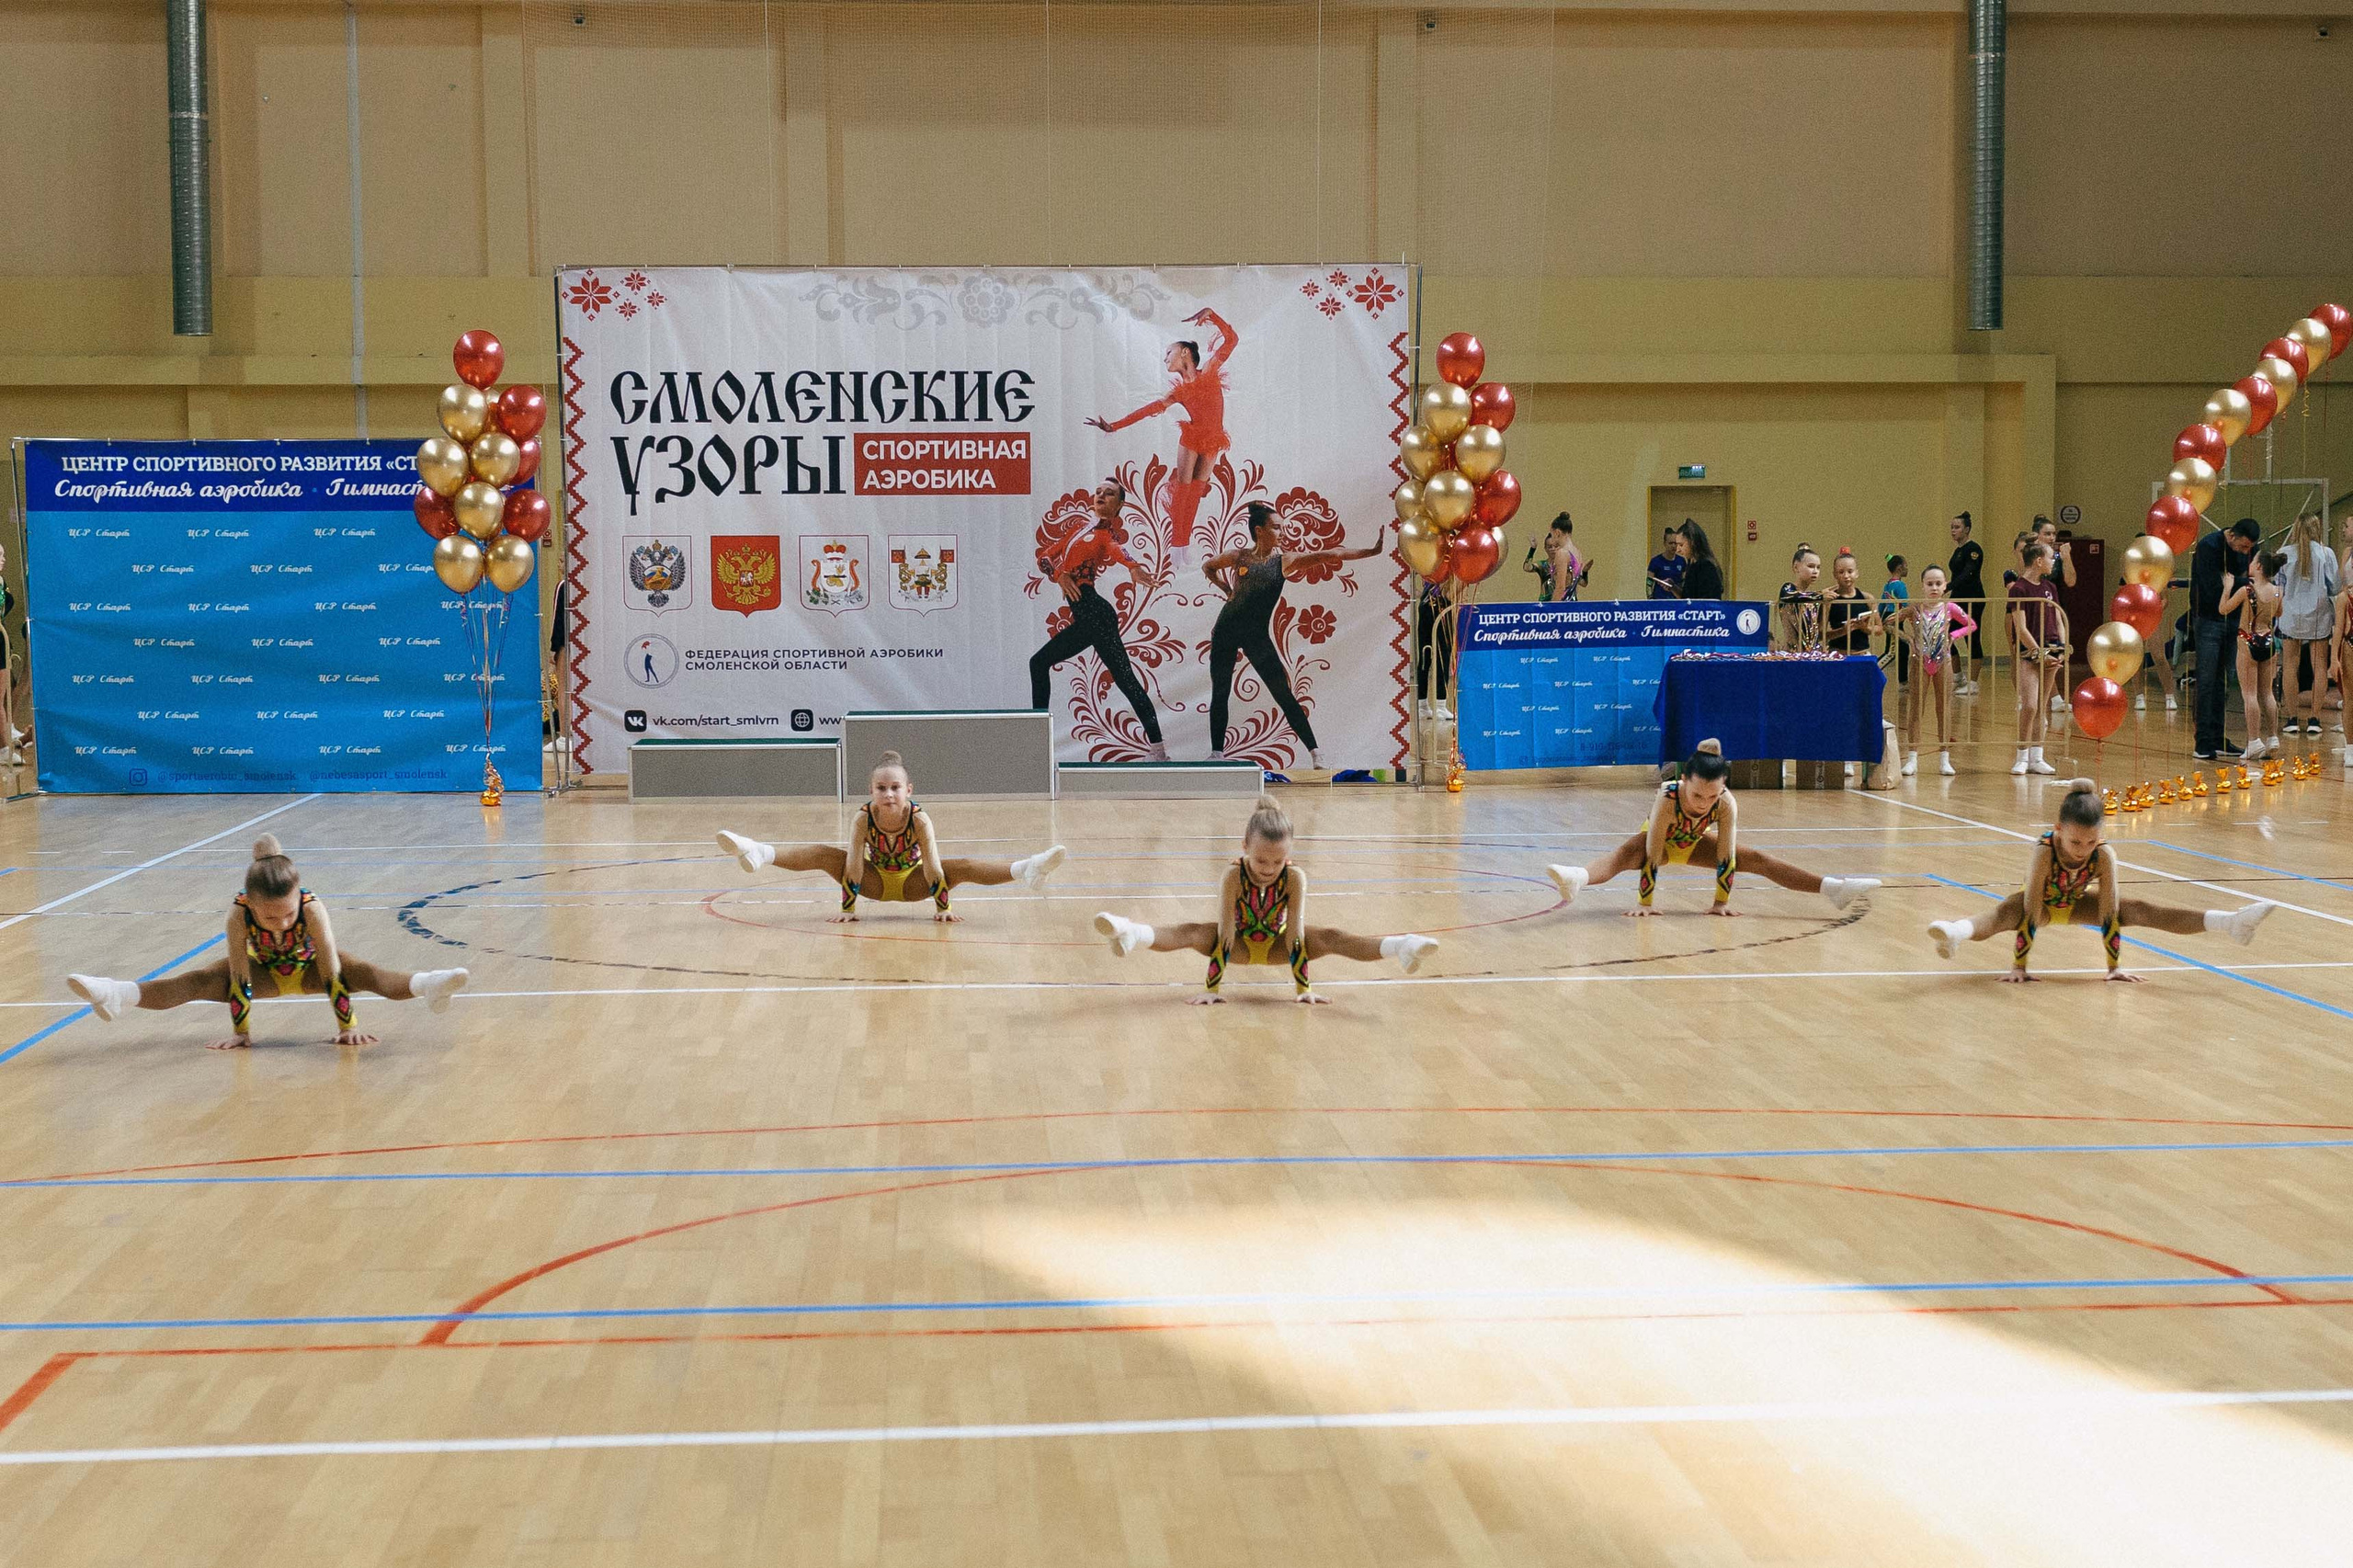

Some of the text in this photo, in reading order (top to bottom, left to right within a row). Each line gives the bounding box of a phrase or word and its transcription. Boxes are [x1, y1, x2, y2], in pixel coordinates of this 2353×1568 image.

[609, 369, 1036, 425] СМОЛЕНСКИЕ
[862, 439, 1027, 460] СПОРТИВНАЯ
[62, 456, 129, 475] ЦЕНТР
[132, 456, 277, 472] СПОРТИВНОГО
[279, 455, 382, 472] РАЗВИТИЯ
[609, 433, 847, 517] УЗОРЫ
[862, 469, 996, 490] АЭРОБИКА
[54, 478, 425, 504] Спортивная аэробика Гимнаст
[68, 528, 131, 540] ЦСР Старт
[188, 528, 250, 540] ЦСР Старт
[313, 528, 376, 539] ЦСР Старт
[131, 564, 194, 575] ЦСР Старт
[250, 564, 313, 574] ЦСР Старт
[379, 563, 435, 574] ЦСР Стар
[69, 602, 131, 613] ЦСР Старт
[188, 602, 250, 614] ЦСР Старт
[314, 601, 377, 613] ЦСР Старт
[1478, 609, 1726, 627] ЦЕНТР СПОРТИВНОГО РАЗВИТИЯ «СТАРТ»
[1473, 624, 1731, 645] Спортивная аэробика Гимнастика
[134, 638, 196, 649] ЦСР Старт
[252, 638, 314, 649] ЦСР Старт
[379, 637, 441, 648] ЦСР Старт
[685, 647, 943, 660] ФЕДЕРАЦИЯ СПОРТИВНОЙ АЭРОБИКИ
[685, 659, 847, 671] СМОЛЕНСКОЙ ОБЛАСТИ
[73, 675, 135, 686] ЦСР Старт
[191, 675, 254, 686] ЦСР Старт
[319, 674, 381, 685] ЦСР Старт
[444, 673, 466, 683] ЦСР
[138, 710, 199, 722] ЦСР Старт
[256, 710, 318, 721] ЦСР Старт
[383, 710, 445, 720] ЦСР Старт
[652, 714, 779, 728] vk.com/start_smlvrn
[818, 717, 842, 725] ww
[74, 745, 137, 757] ЦСР Старт
[192, 745, 254, 757] ЦСР Старт
[319, 745, 381, 756] ЦСР Старт
[446, 744, 469, 755] ЦСР
